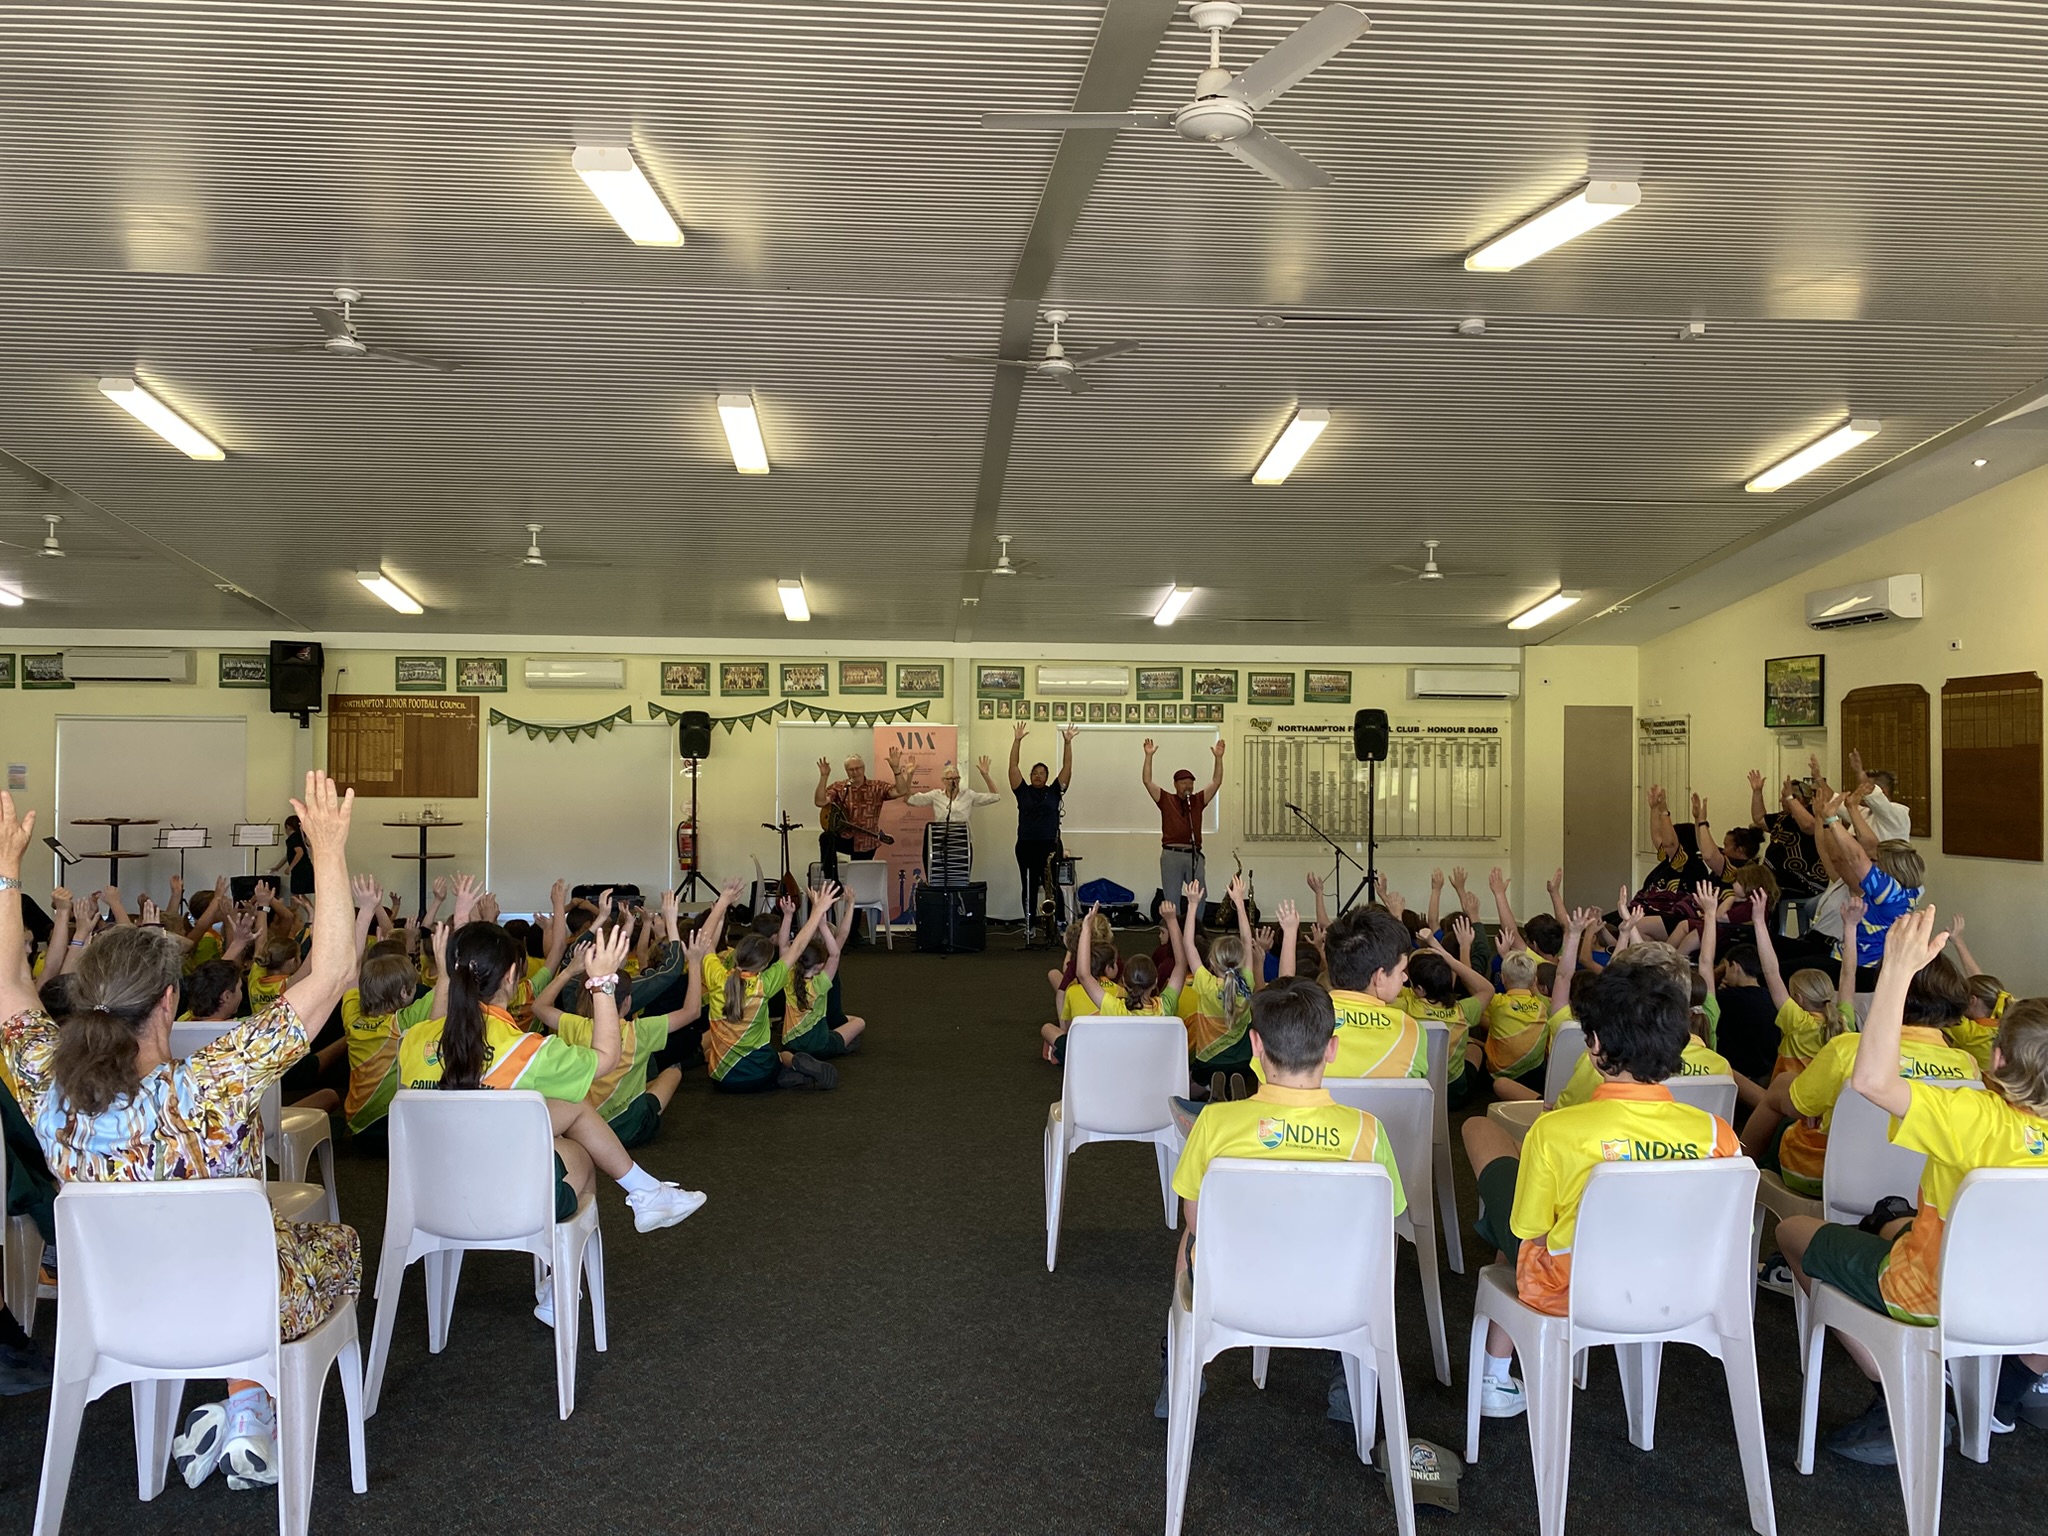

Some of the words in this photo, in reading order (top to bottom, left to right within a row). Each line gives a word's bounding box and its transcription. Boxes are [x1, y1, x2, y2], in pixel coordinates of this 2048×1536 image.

[385, 698, 407, 708] JUNIOR
[408, 699, 439, 708] FOOTBALL
[439, 700, 466, 709] COUNCIL
[1346, 1011, 1391, 1026] NDHS
[1681, 1061, 1710, 1075] DHS
[1915, 1061, 1964, 1078] NDHS
[1286, 1123, 1340, 1146] NDHS
[1635, 1141, 1700, 1160] NDHS
